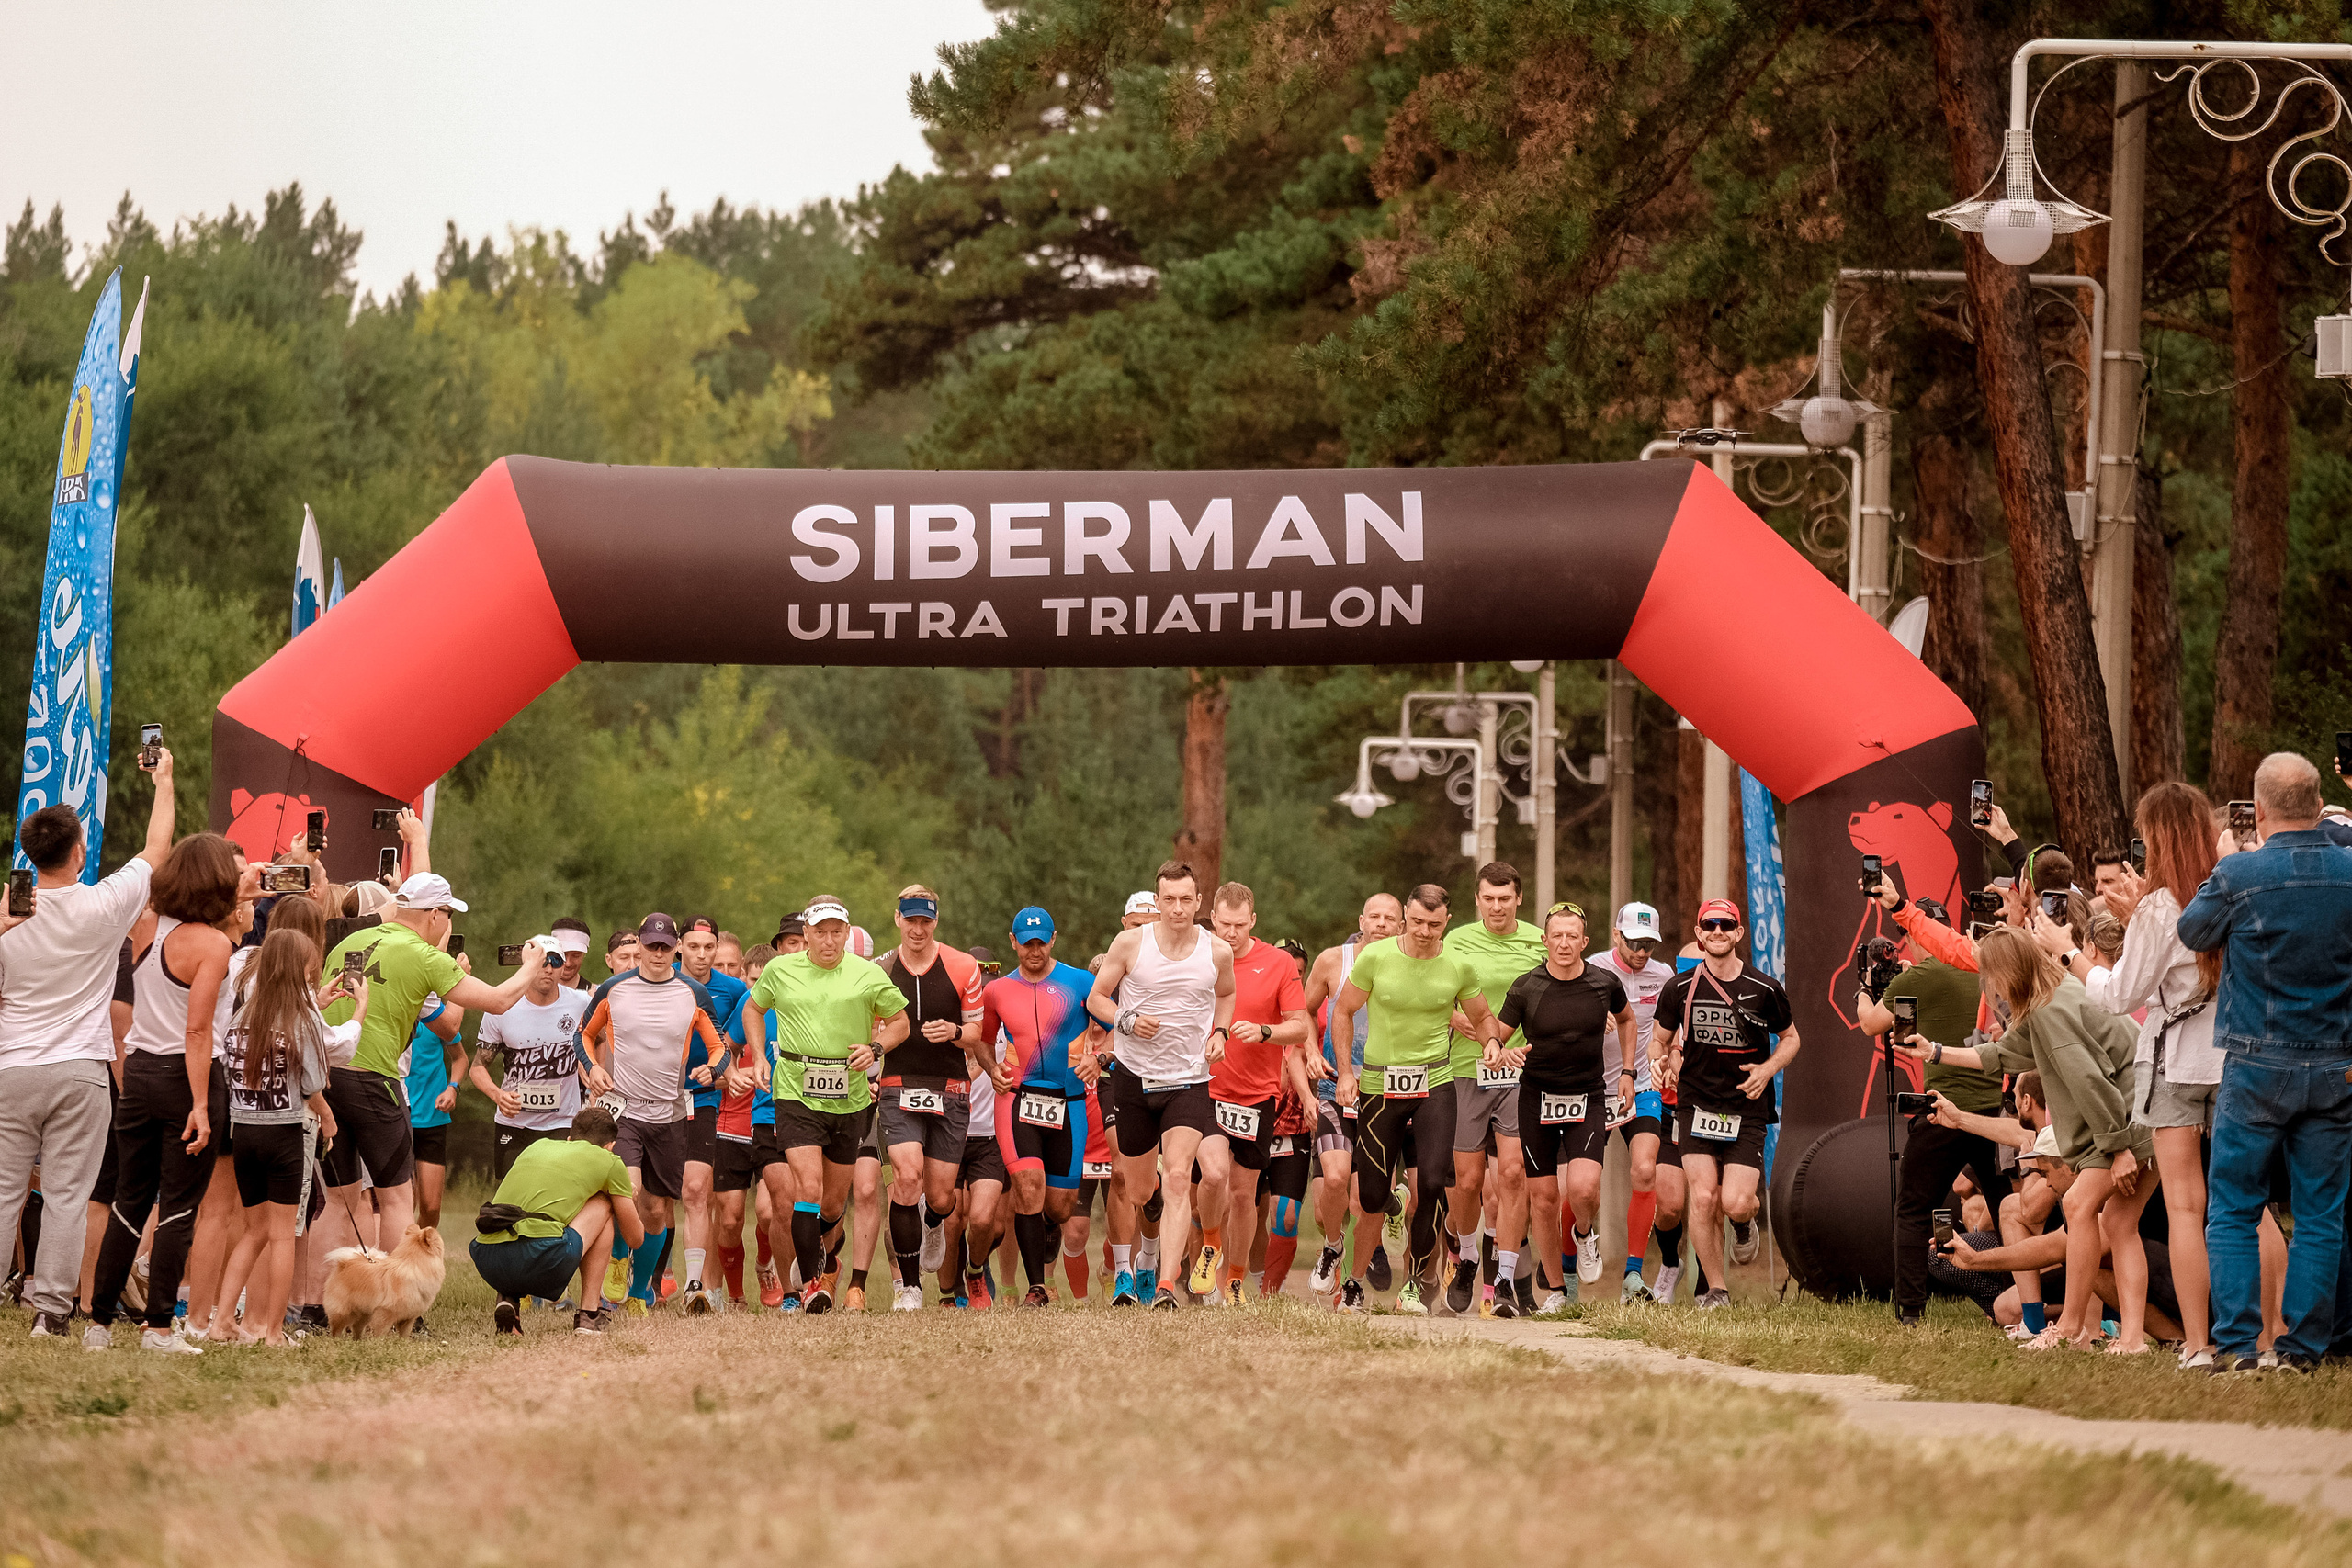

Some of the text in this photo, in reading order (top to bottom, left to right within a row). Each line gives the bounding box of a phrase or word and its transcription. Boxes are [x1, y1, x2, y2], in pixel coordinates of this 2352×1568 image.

[789, 491, 1424, 583] SIBERMAN
[787, 584, 1424, 641] ULTRA TRIATHLON
[1696, 1010, 1736, 1026] ЭРК
[808, 1077, 844, 1090] 1016
[1387, 1074, 1424, 1091] 107
[523, 1093, 555, 1106] 1013
[910, 1095, 935, 1108] 56
[1024, 1101, 1057, 1122] 116
[1544, 1102, 1581, 1119] 100
[1220, 1110, 1252, 1133] 113
[1699, 1117, 1733, 1134] 1011
